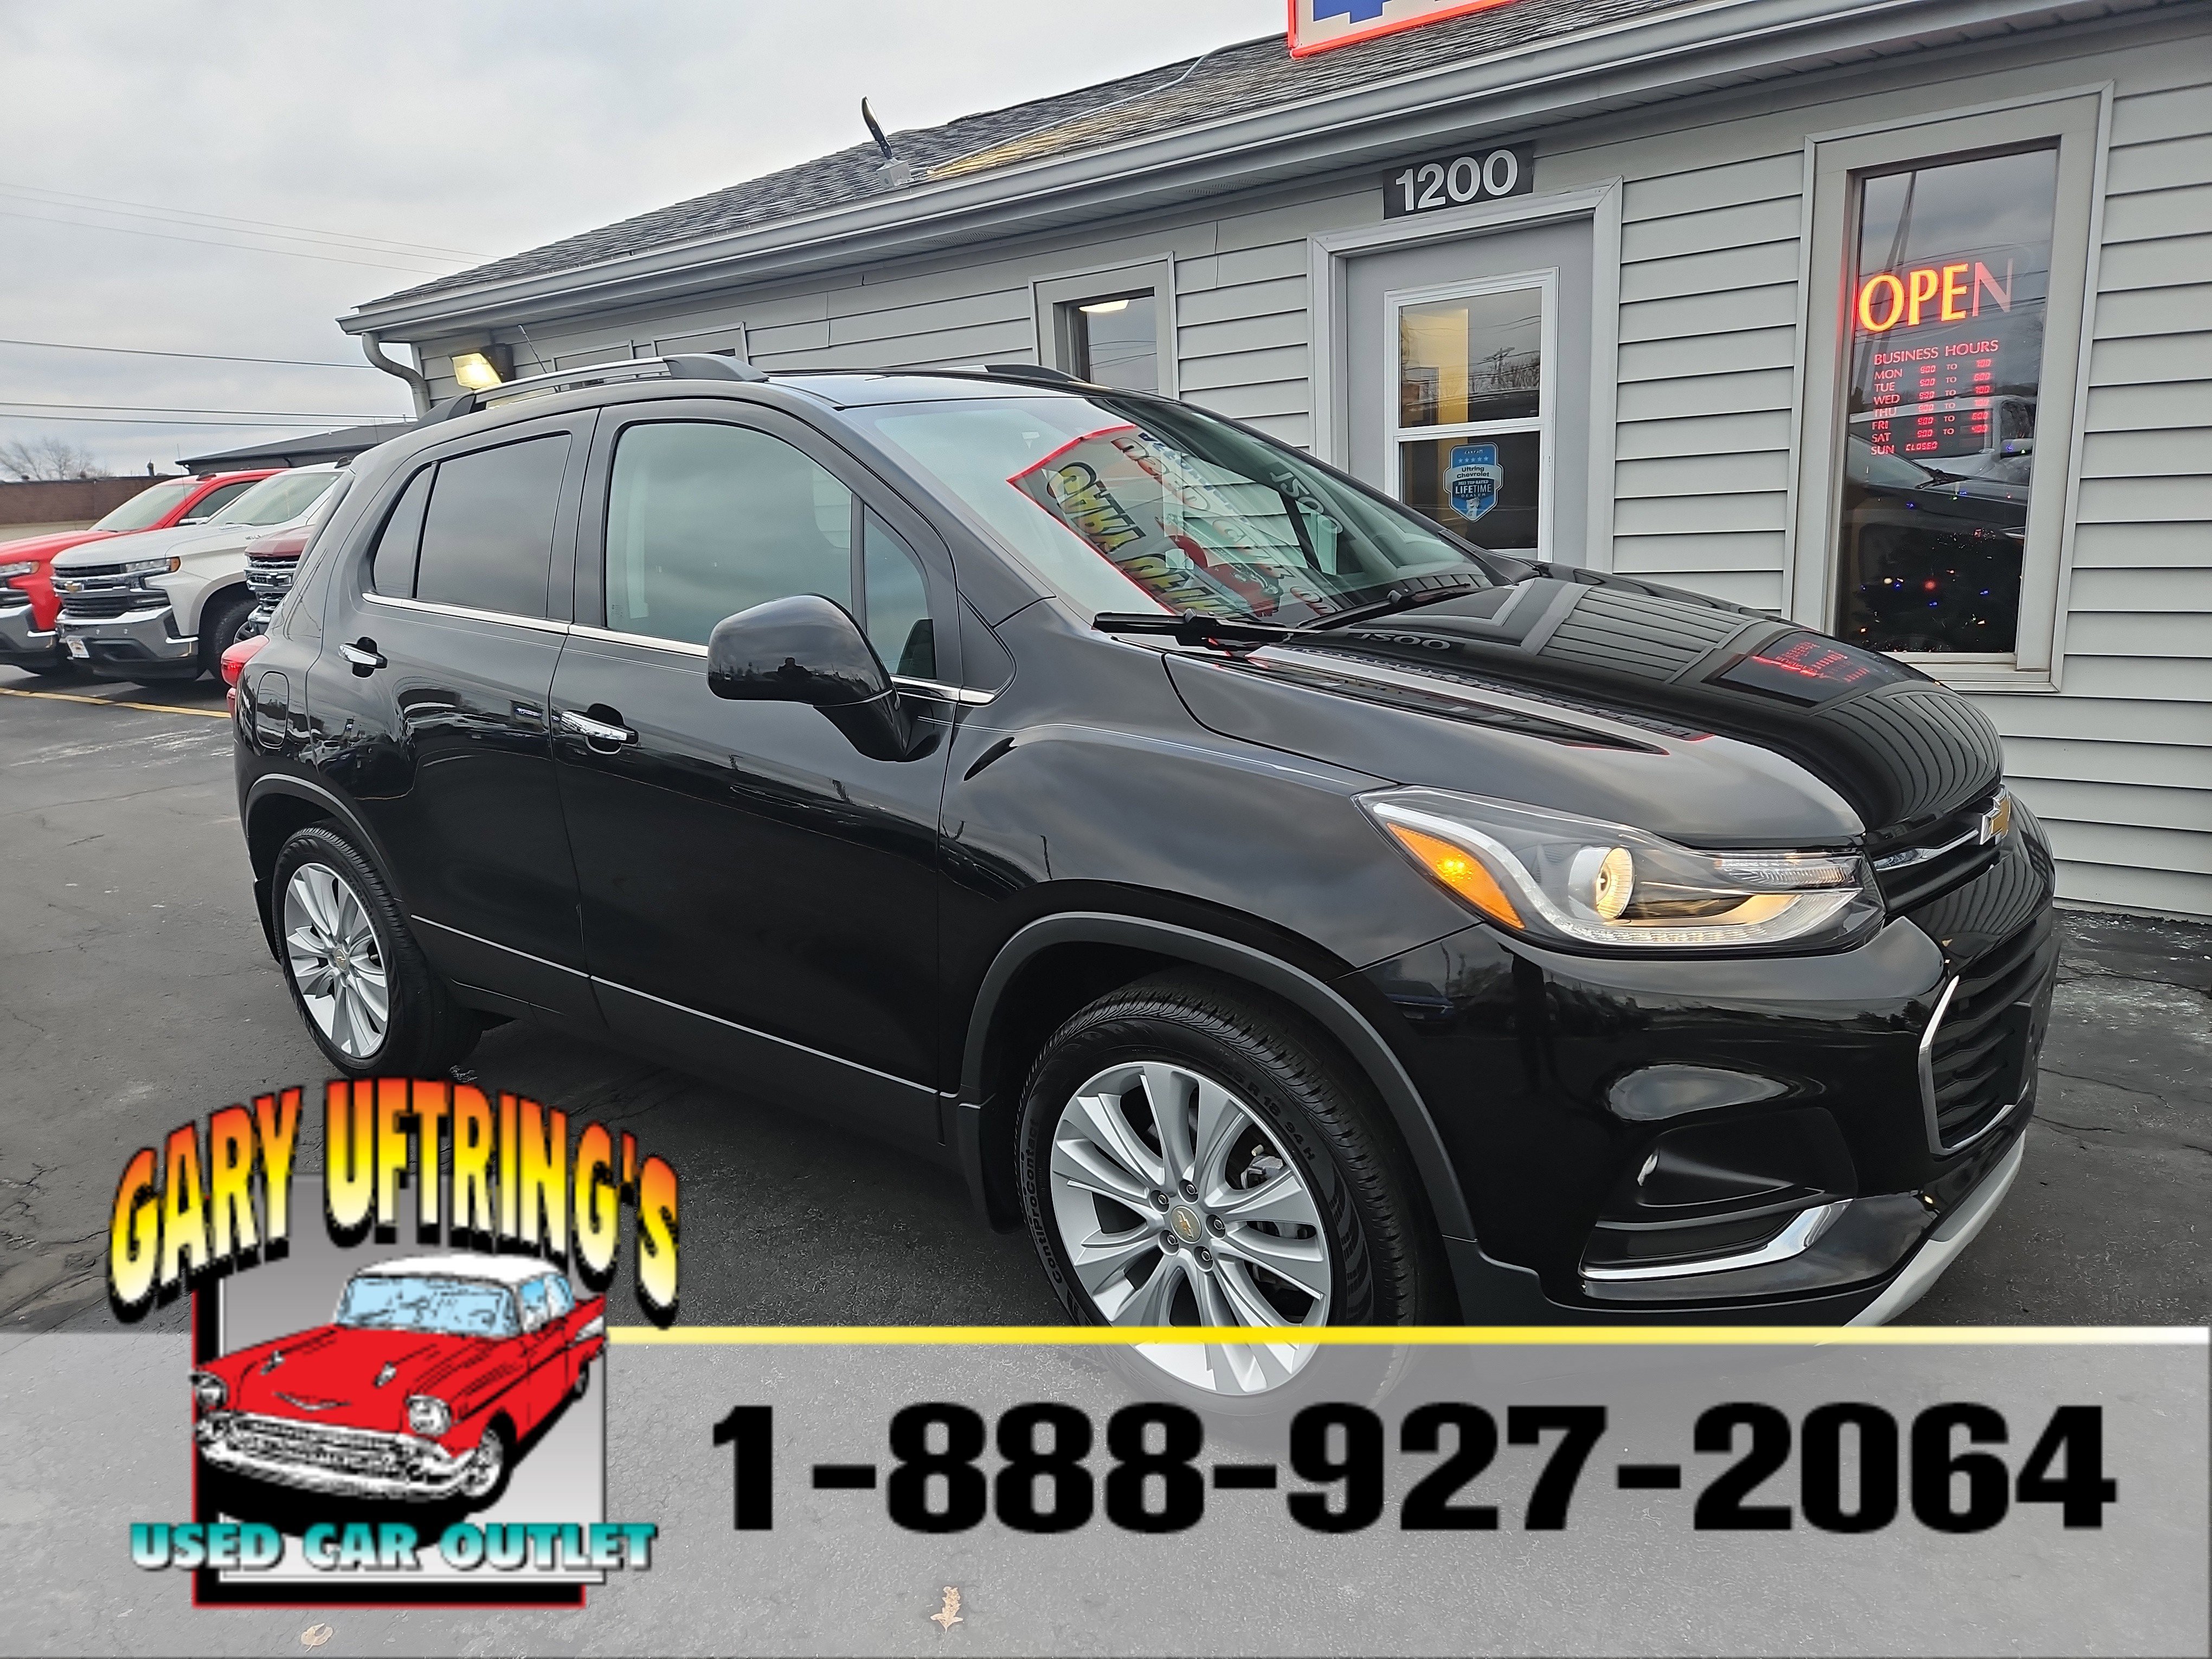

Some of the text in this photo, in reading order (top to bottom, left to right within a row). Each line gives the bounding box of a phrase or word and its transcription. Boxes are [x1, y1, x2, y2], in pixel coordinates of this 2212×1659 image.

[1396, 149, 1517, 211] 1200
[1859, 258, 2014, 332] OPEN
[1874, 340, 1999, 366] BUSINESS HOURS
[1874, 369, 1902, 380] MON
[1874, 382, 1895, 393] TUE
[1874, 394, 1900, 405] WED
[1874, 407, 1896, 417] THU
[1872, 421, 1888, 430] FRI
[1872, 432, 1891, 442] SAT
[1870, 441, 1938, 455] SUN CLOSED
[1455, 484, 1491, 494] LIFETIME
